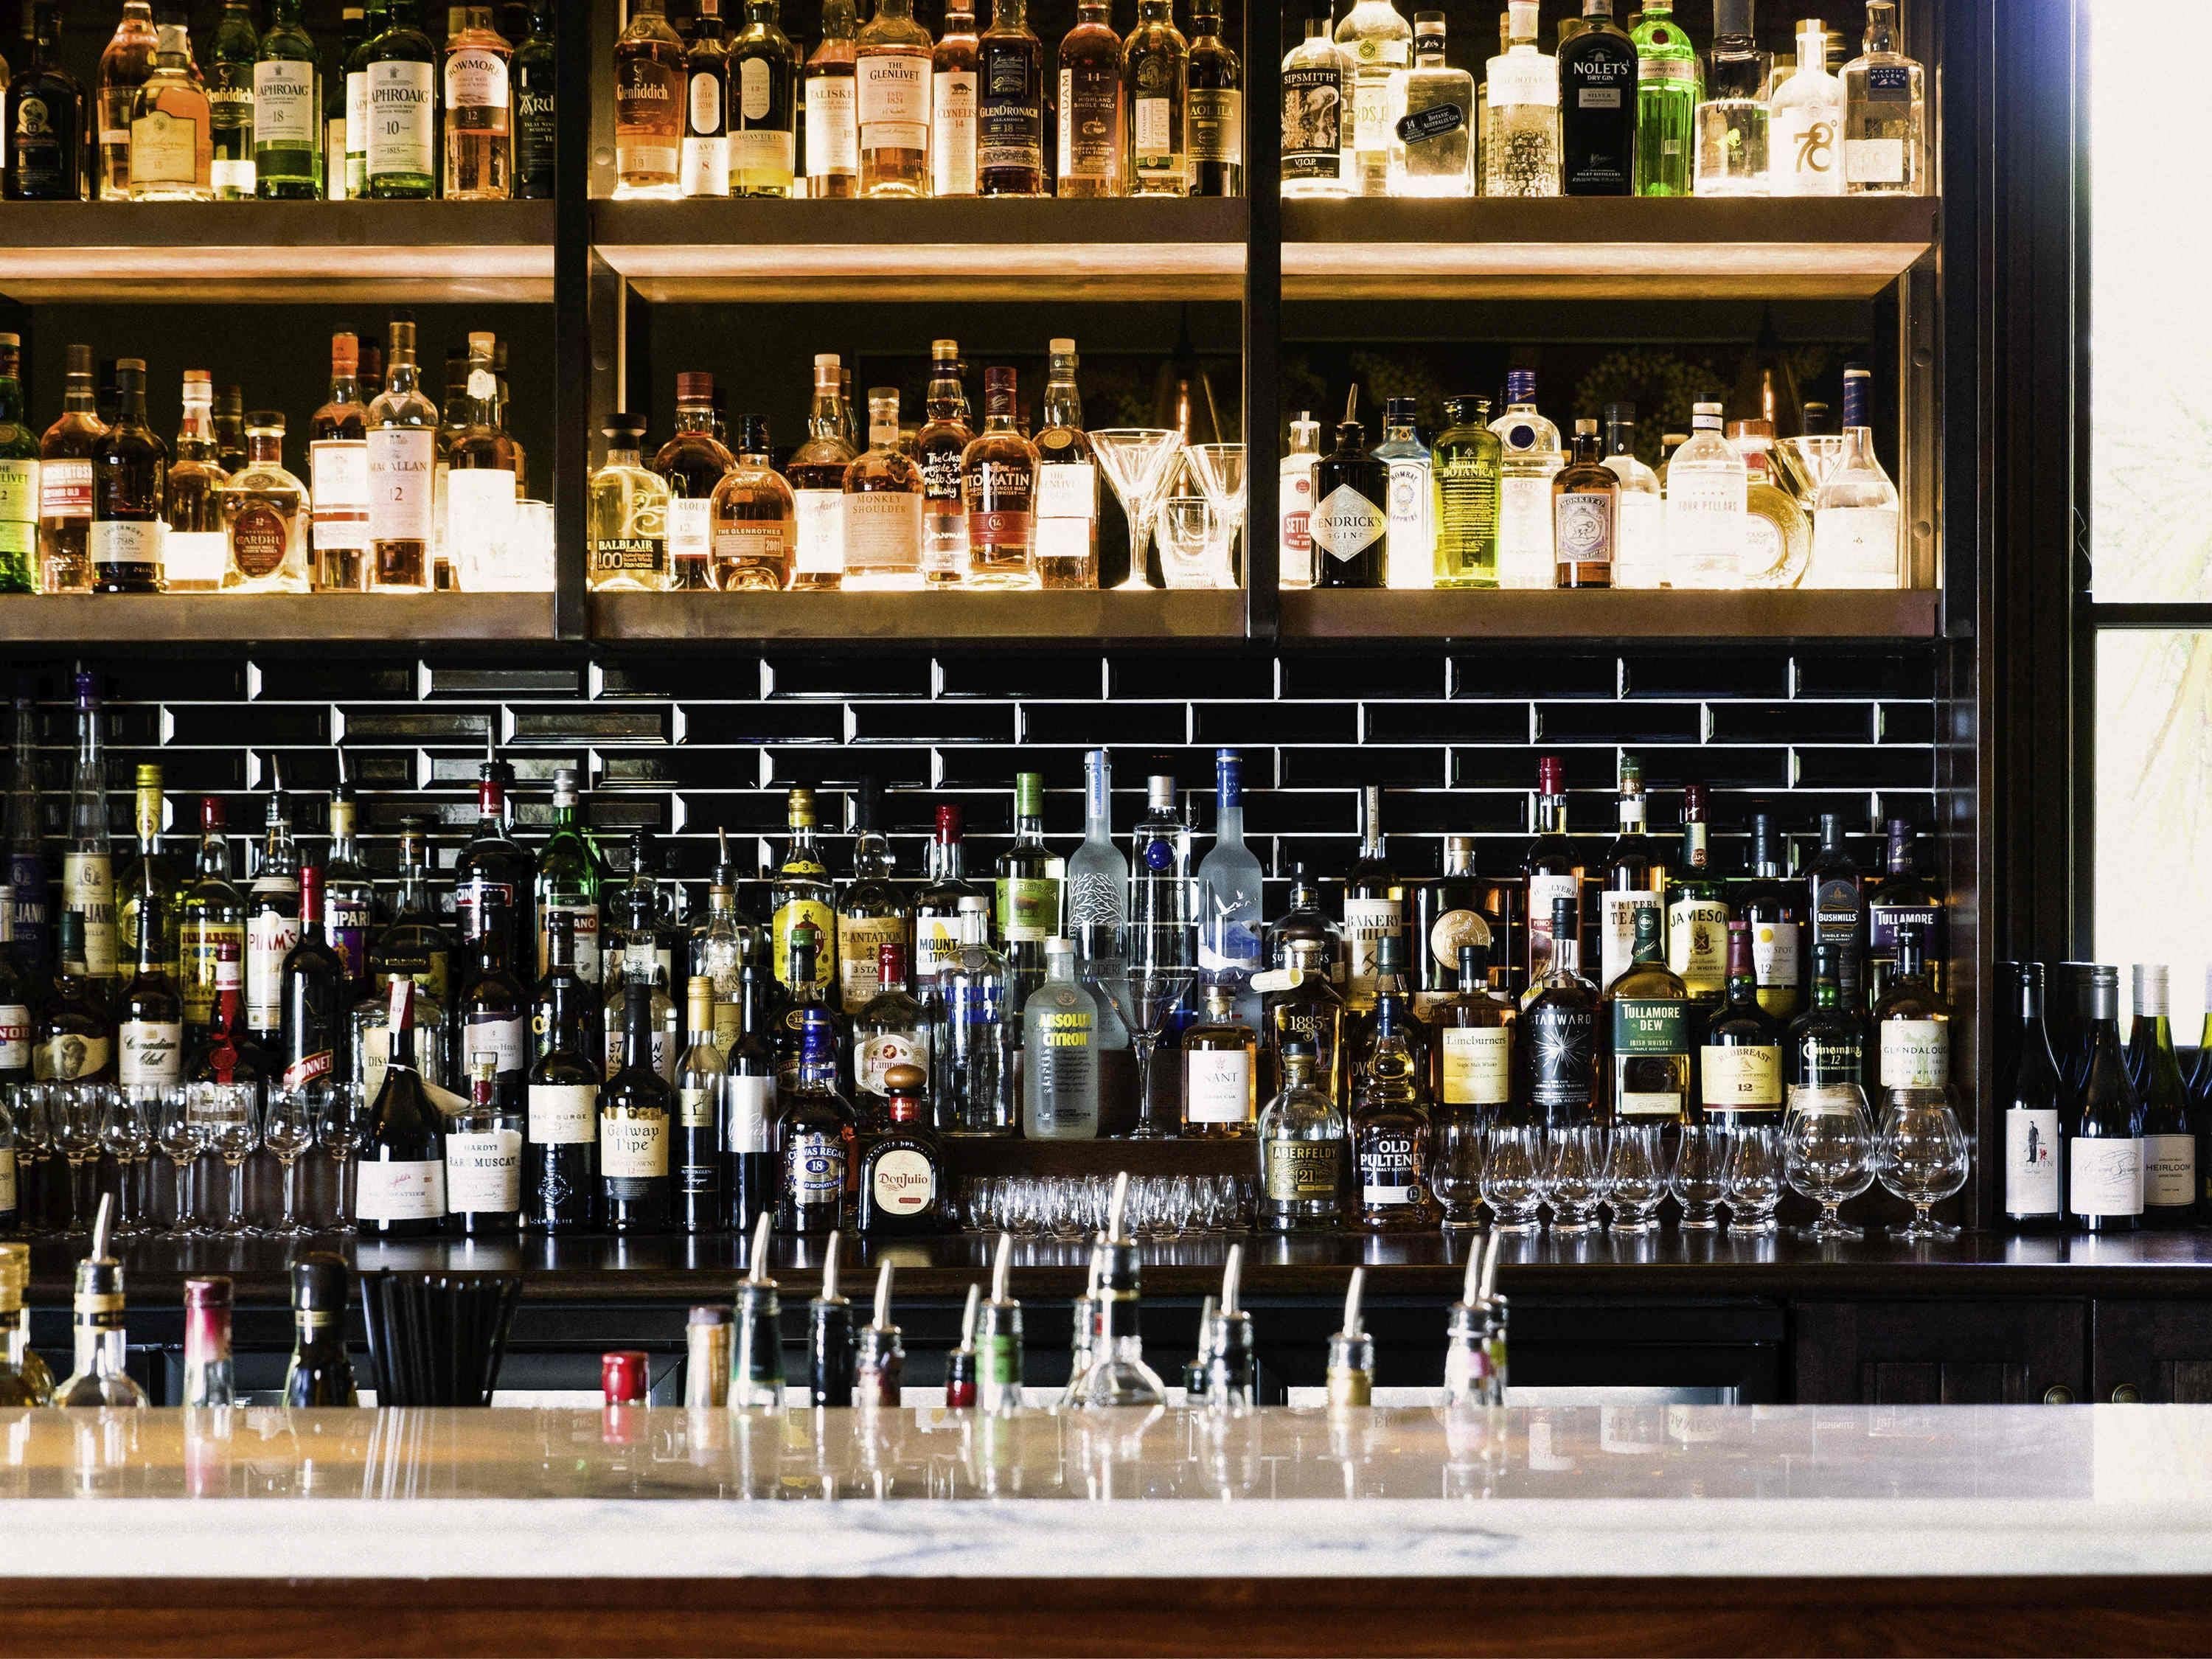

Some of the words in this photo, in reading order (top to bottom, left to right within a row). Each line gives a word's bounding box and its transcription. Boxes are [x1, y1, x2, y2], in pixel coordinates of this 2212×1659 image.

[887, 61, 903, 69] THE
[1573, 60, 1629, 75] NOLET'S
[869, 69, 921, 81] GLENLIVET
[1284, 72, 1335, 85] SIPSMITH
[616, 83, 669, 101] Glenfiddich
[810, 88, 855, 100] TALISKE
[467, 111, 478, 120] 12
[937, 108, 976, 119] CLYNELIS
[1189, 105, 1212, 116] AOL
[386, 120, 400, 136] 10
[701, 160, 710, 171] 8
[927, 452, 942, 465] The
[942, 451, 961, 463] Clas
[945, 473, 961, 484] Sco
[1442, 467, 1495, 478] BOTANICA
[967, 473, 1029, 487] TOMATIN
[389, 486, 403, 501] 12
[856, 495, 902, 504] MONKEY
[852, 505, 906, 514] SHOULDER
[992, 519, 1002, 528] 14
[1286, 517, 1310, 534] SETTL
[1315, 515, 1382, 529] ENDRICK'S
[598, 540, 653, 552] BALBLAIR
[802, 863, 809, 872] 3
[1610, 900, 1658, 910] WRITERS
[335, 911, 371, 928] PARI
[1346, 914, 1400, 928] BAKERY
[1532, 919, 1553, 928] PINO
[1610, 911, 1636, 925] TEA
[1817, 912, 1857, 923] BUSHMILLS
[1874, 911, 1934, 925] TULLAMORE
[841, 931, 902, 943] PLANTATION
[919, 938, 959, 951] MOUNT
[853, 966, 858, 974] 3
[860, 966, 879, 974] STA
[1760, 963, 1772, 974] 12
[1621, 1004, 1680, 1019] TULLAMORE
[1289, 1015, 1324, 1032] 1885
[1639, 1019, 1663, 1031] DEW
[123, 1036, 177, 1051] Canadian
[1446, 1035, 1506, 1046] Limeburners
[1883, 1046, 1948, 1056] GLNDALOUG
[138, 1051, 164, 1066] Club
[1831, 1054, 1840, 1065] 12
[1736, 1083, 1753, 1092] 12
[818, 1147, 846, 1159] REGAL
[1273, 1147, 1337, 1158] ABERFELDY
[1378, 1140, 1411, 1154] OLD
[474, 1155, 516, 1167] MUSCAT
[1360, 1152, 1427, 1167] PULTENEY
[810, 1160, 824, 1172] 18
[2146, 1164, 2191, 1172] HEIRLOOM
[1298, 1169, 1315, 1183] 21
[1409, 1189, 1419, 1198] 12
